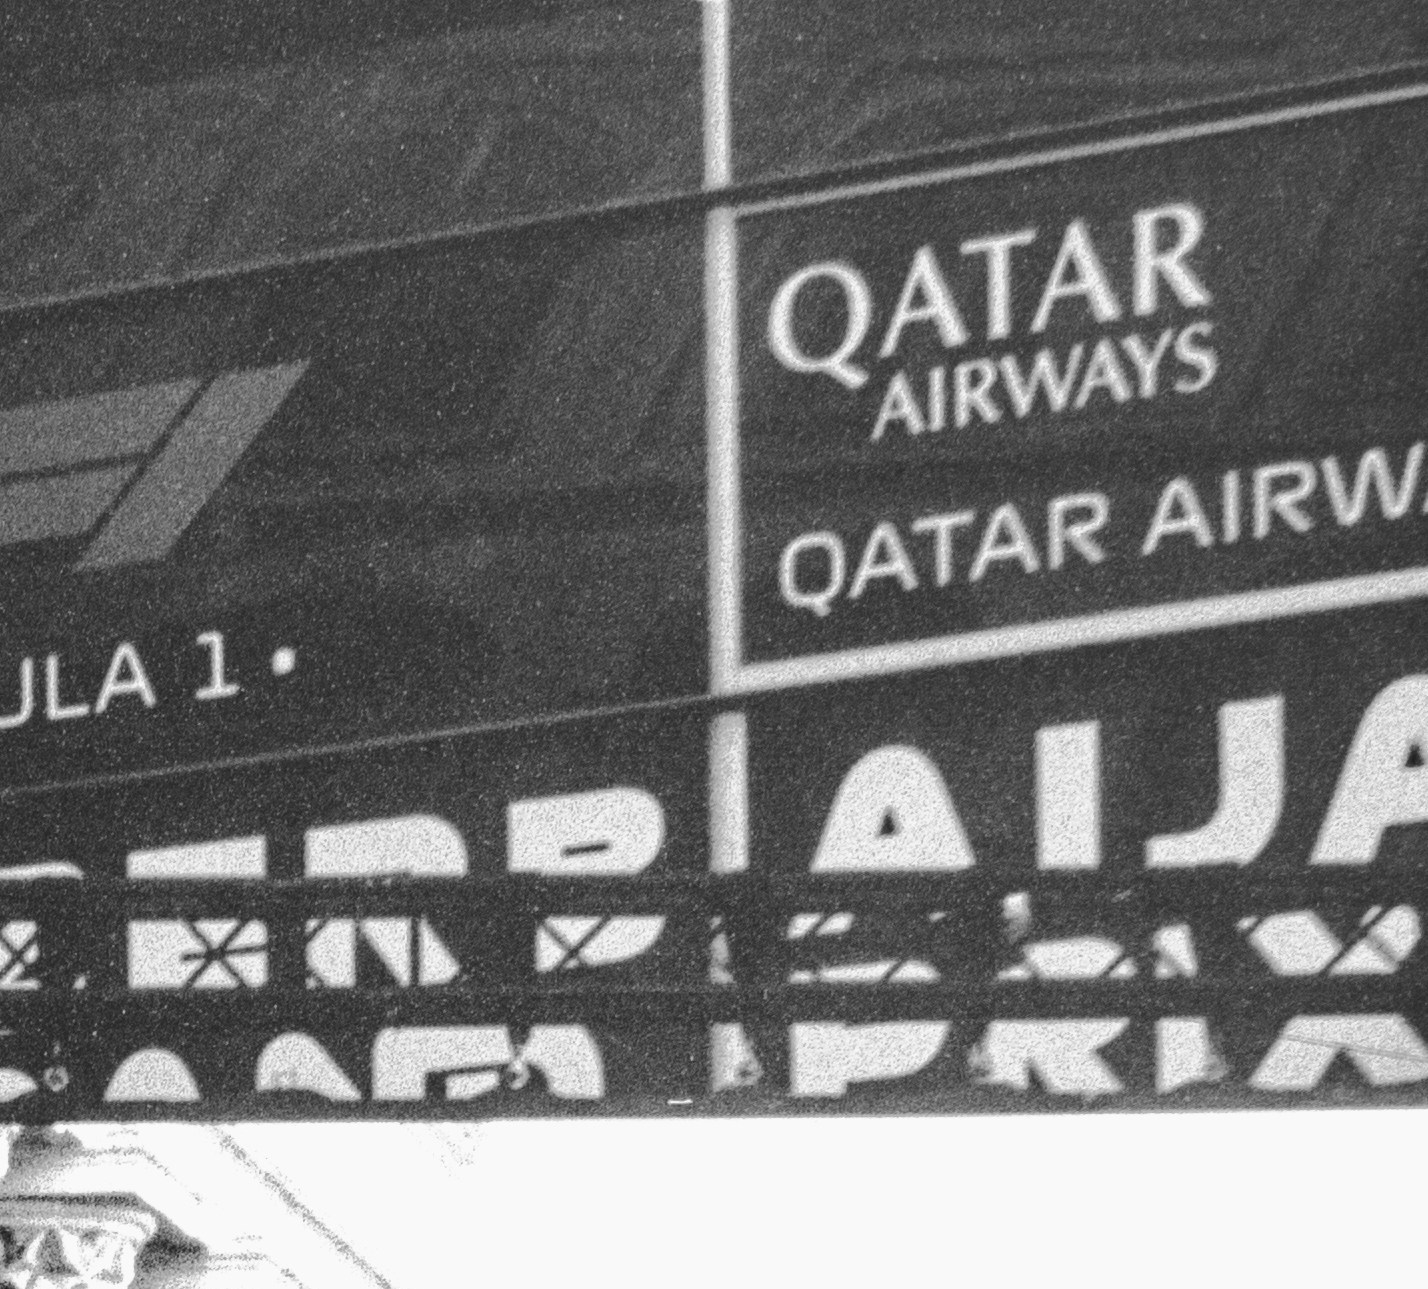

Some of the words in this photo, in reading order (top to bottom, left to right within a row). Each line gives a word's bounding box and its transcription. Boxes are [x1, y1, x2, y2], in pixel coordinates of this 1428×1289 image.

[767, 200, 1212, 389] QATAR
[869, 321, 1219, 441] AIRWAYS
[778, 490, 1112, 617] QATAR
[1141, 440, 1428, 556] AIRW
